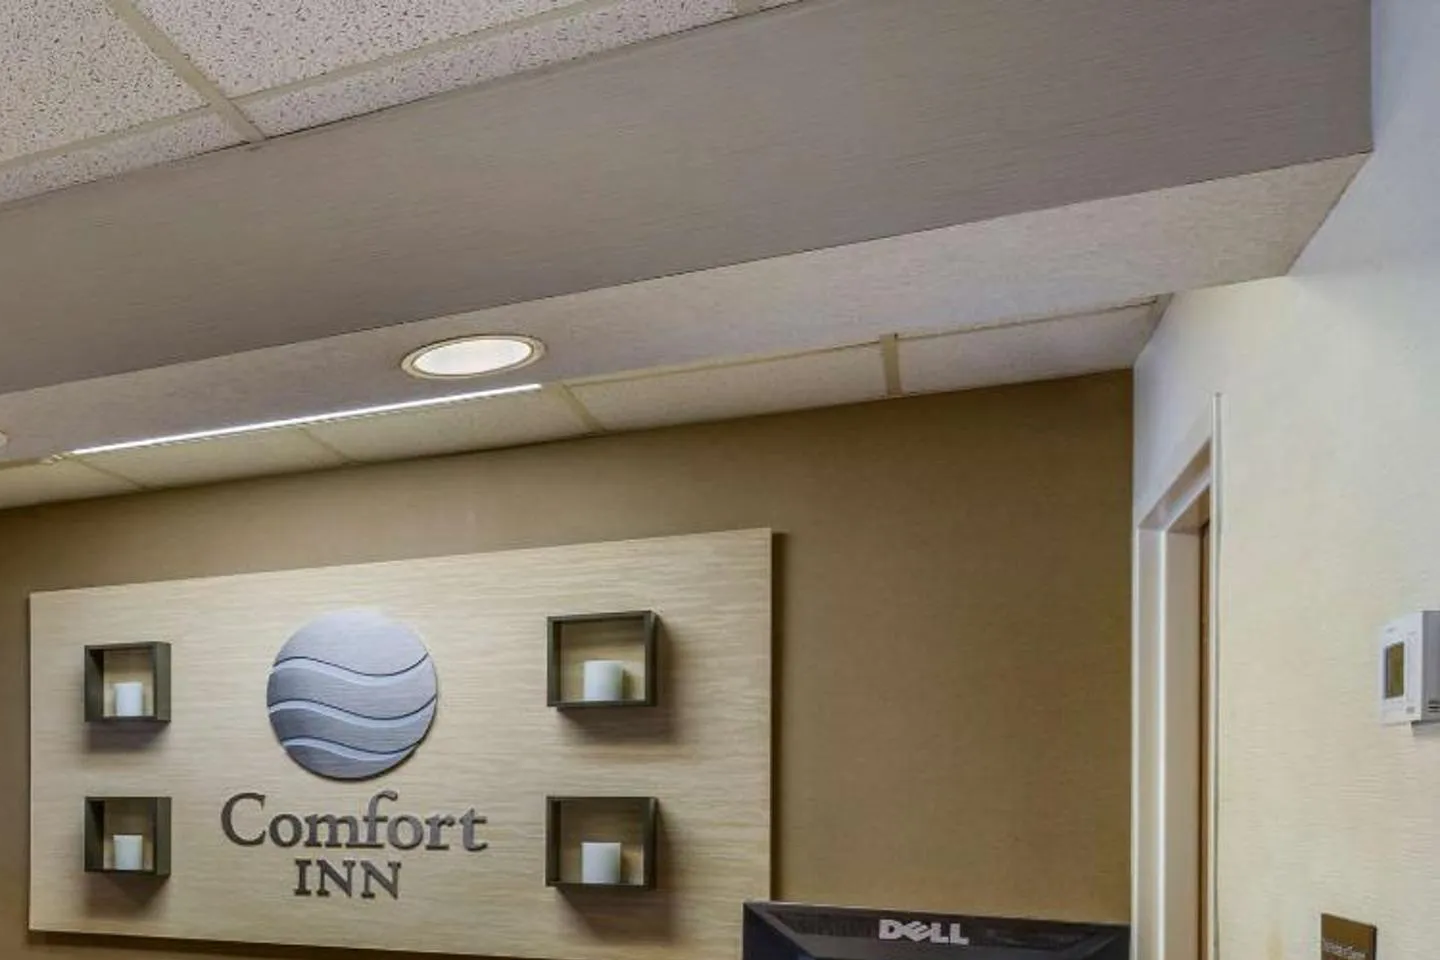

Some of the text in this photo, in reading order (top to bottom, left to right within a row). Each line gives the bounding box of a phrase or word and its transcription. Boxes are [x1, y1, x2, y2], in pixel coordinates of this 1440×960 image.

[220, 791, 488, 851] Comfort
[294, 858, 402, 900] INN
[879, 919, 969, 945] DELL
